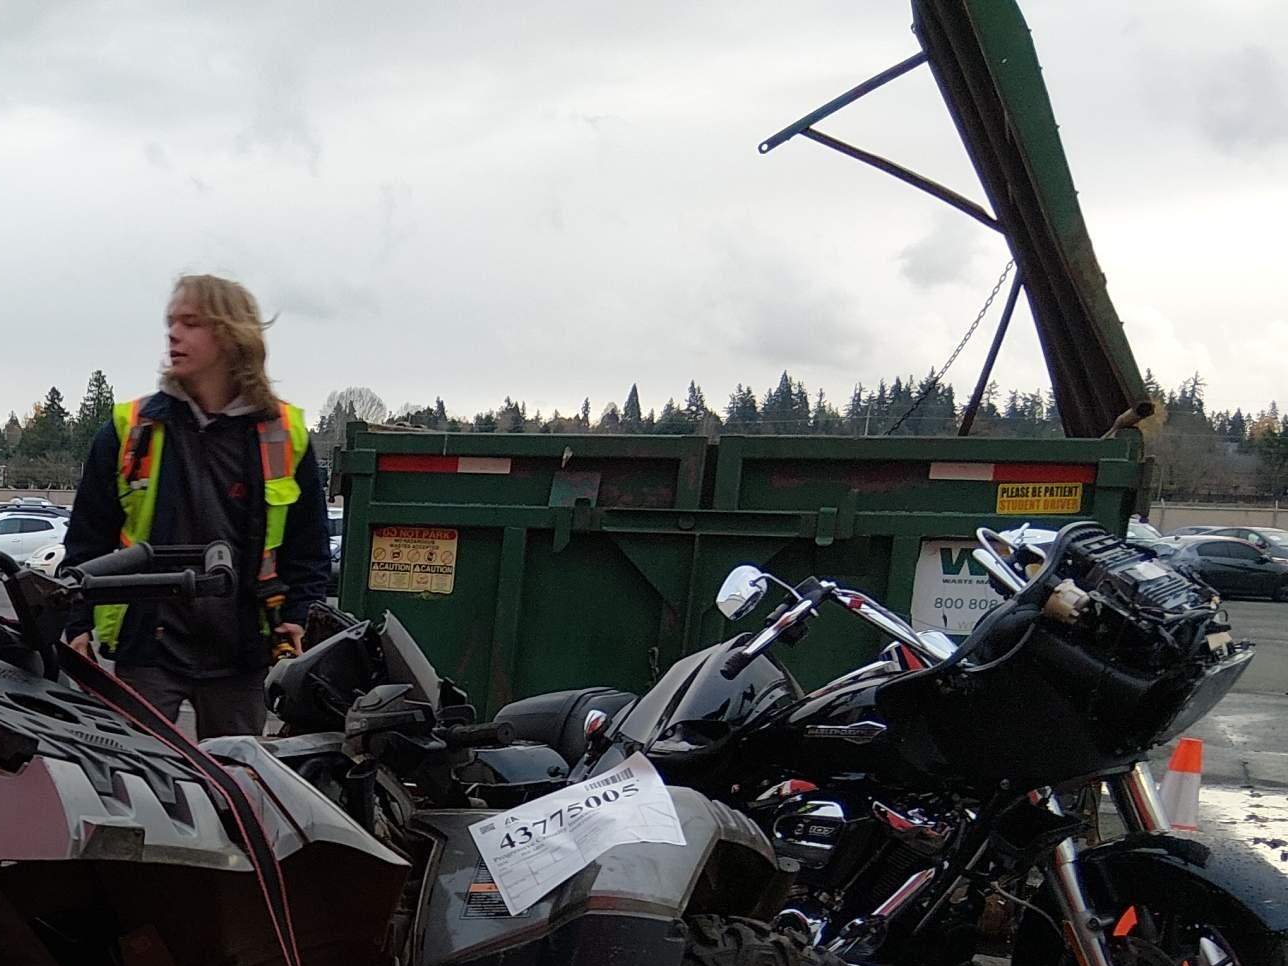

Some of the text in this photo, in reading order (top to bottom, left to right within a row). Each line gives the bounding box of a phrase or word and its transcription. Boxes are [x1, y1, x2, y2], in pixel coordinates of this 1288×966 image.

[1002, 486, 1079, 498] PLEASE BE PATIENT
[1000, 499, 1040, 510] STUDENT
[382, 528, 452, 540] DO NOT PARK
[379, 562, 410, 572] CAUTION
[421, 565, 453, 574] CAUTION
[934, 597, 999, 610] 800 808
[500, 783, 640, 849] 43775005
